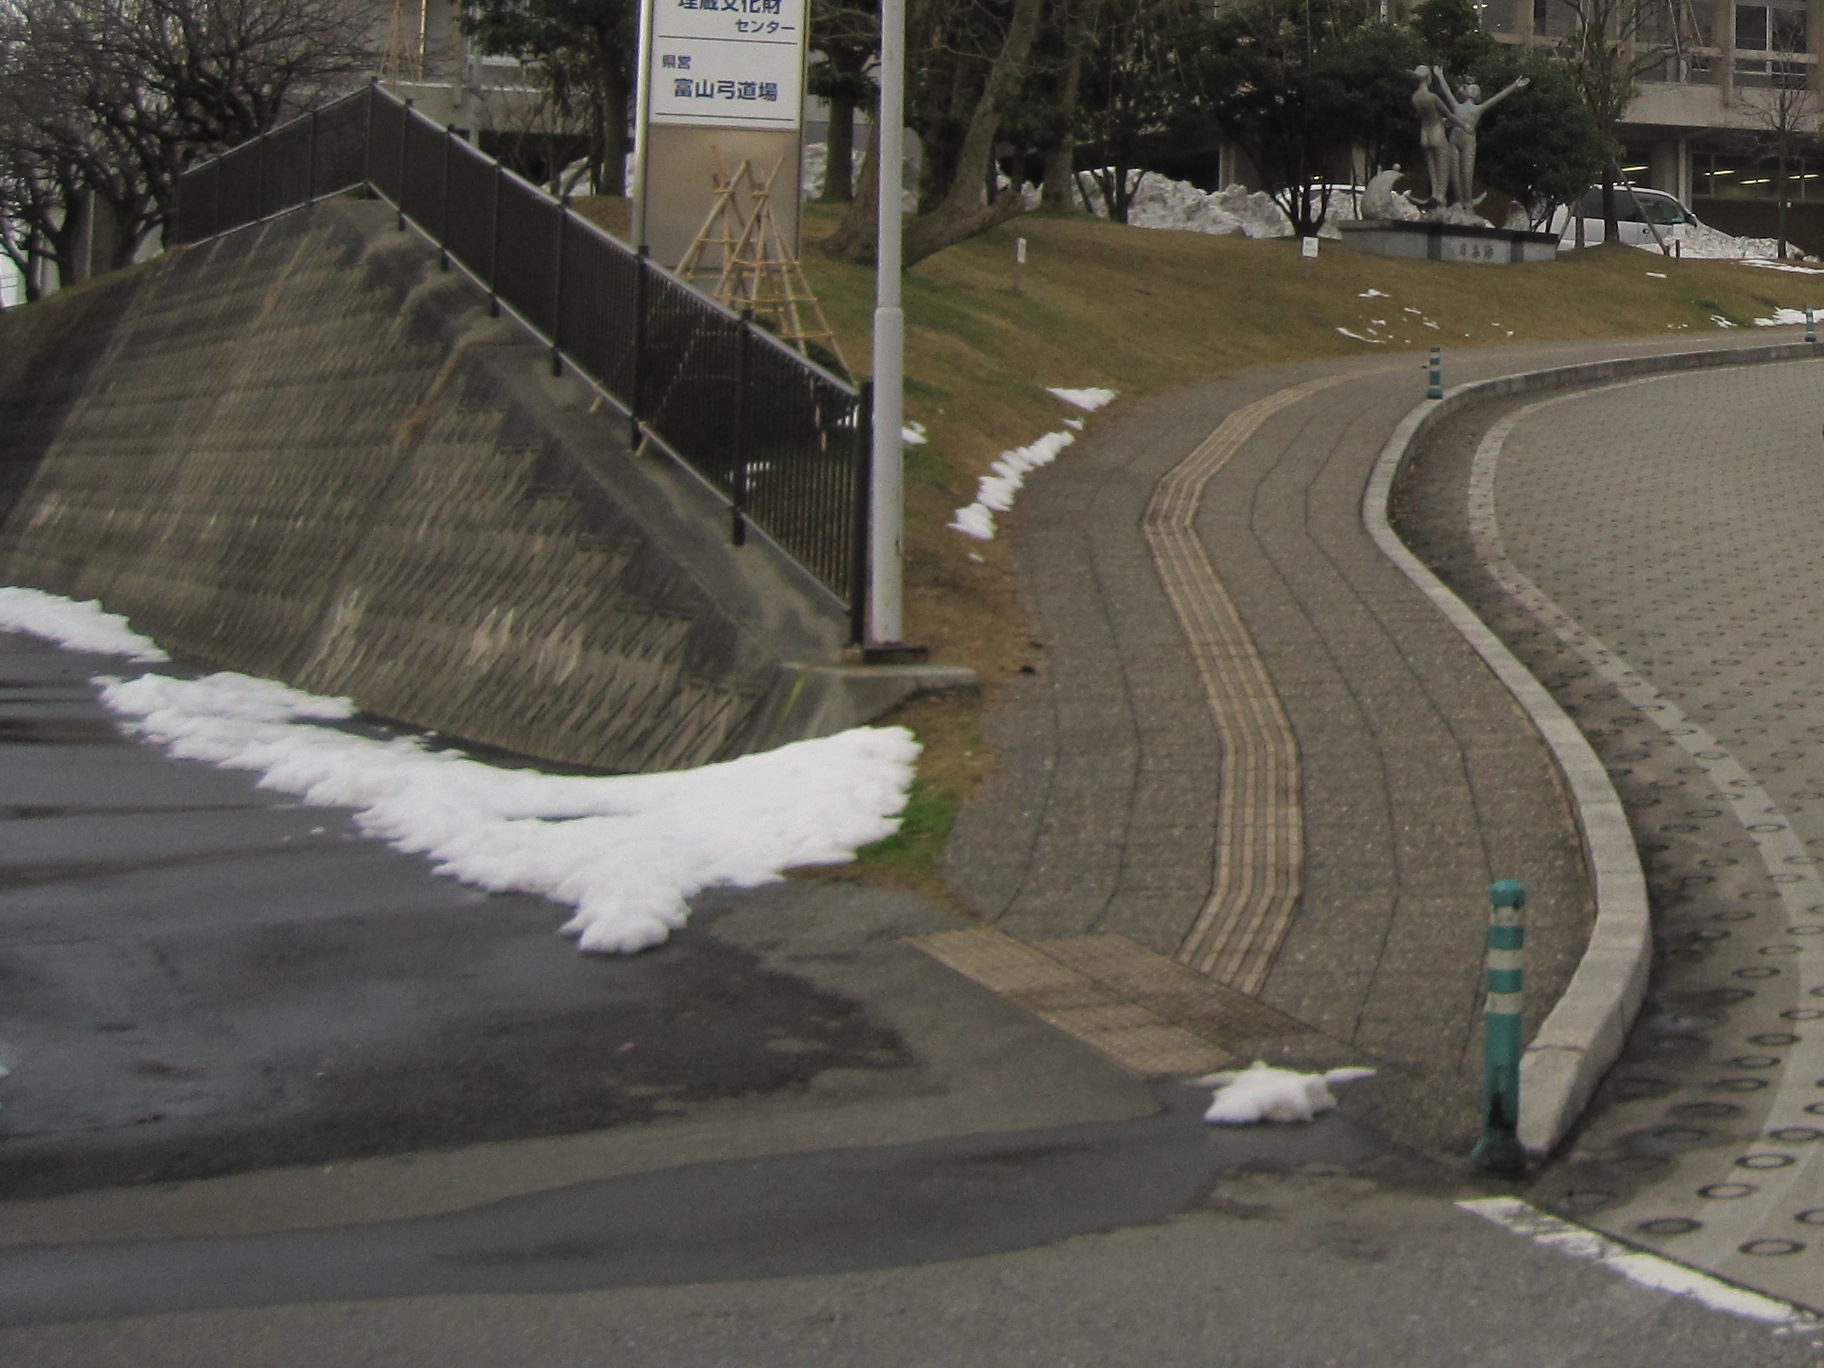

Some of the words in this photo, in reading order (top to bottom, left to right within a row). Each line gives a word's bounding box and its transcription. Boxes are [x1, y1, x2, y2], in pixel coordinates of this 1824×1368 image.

[735, 19, 795, 34] センター
[662, 54, 692, 69] 県営
[674, 78, 779, 102] 富山弓道場
